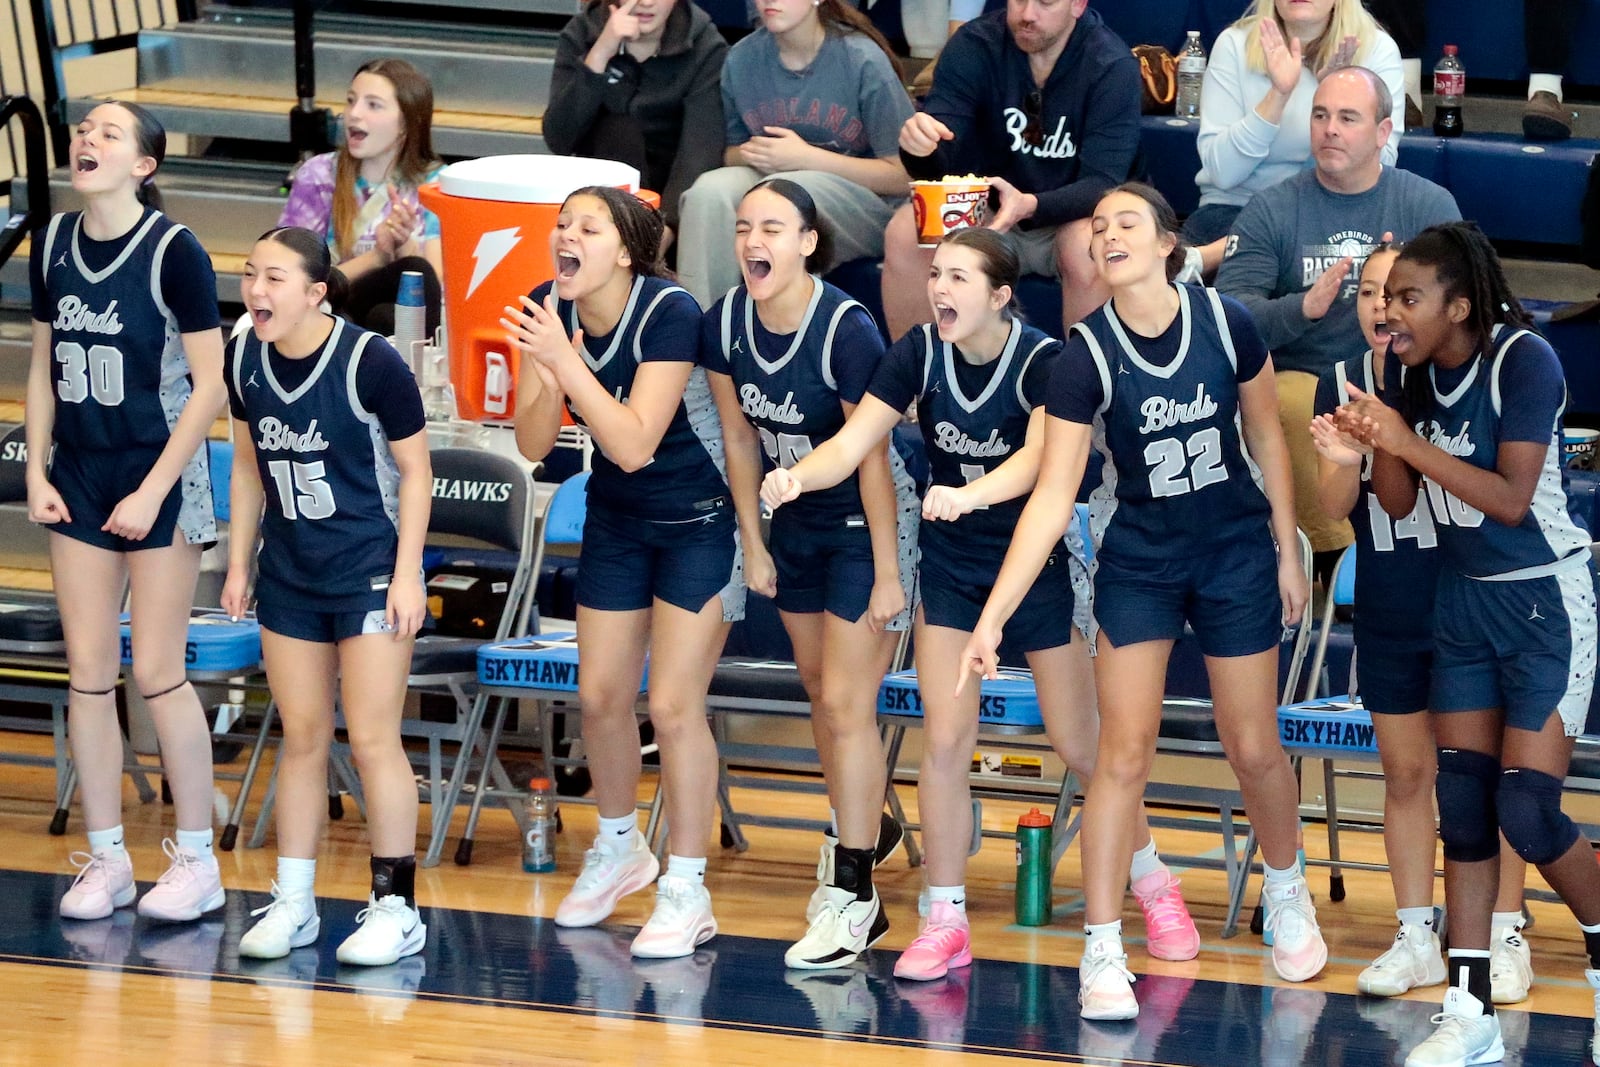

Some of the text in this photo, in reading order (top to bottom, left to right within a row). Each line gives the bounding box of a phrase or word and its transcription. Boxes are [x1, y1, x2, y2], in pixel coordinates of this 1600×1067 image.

[1327, 230, 1374, 244] FIREBIRDS
[53, 294, 124, 335] Birds
[55, 341, 124, 406] 30
[740, 383, 804, 424] Birds
[1139, 383, 1218, 434] Birds
[258, 416, 329, 453] Birds
[934, 421, 1011, 458] Birds
[1143, 426, 1229, 498] 22
[268, 460, 336, 520] 15
